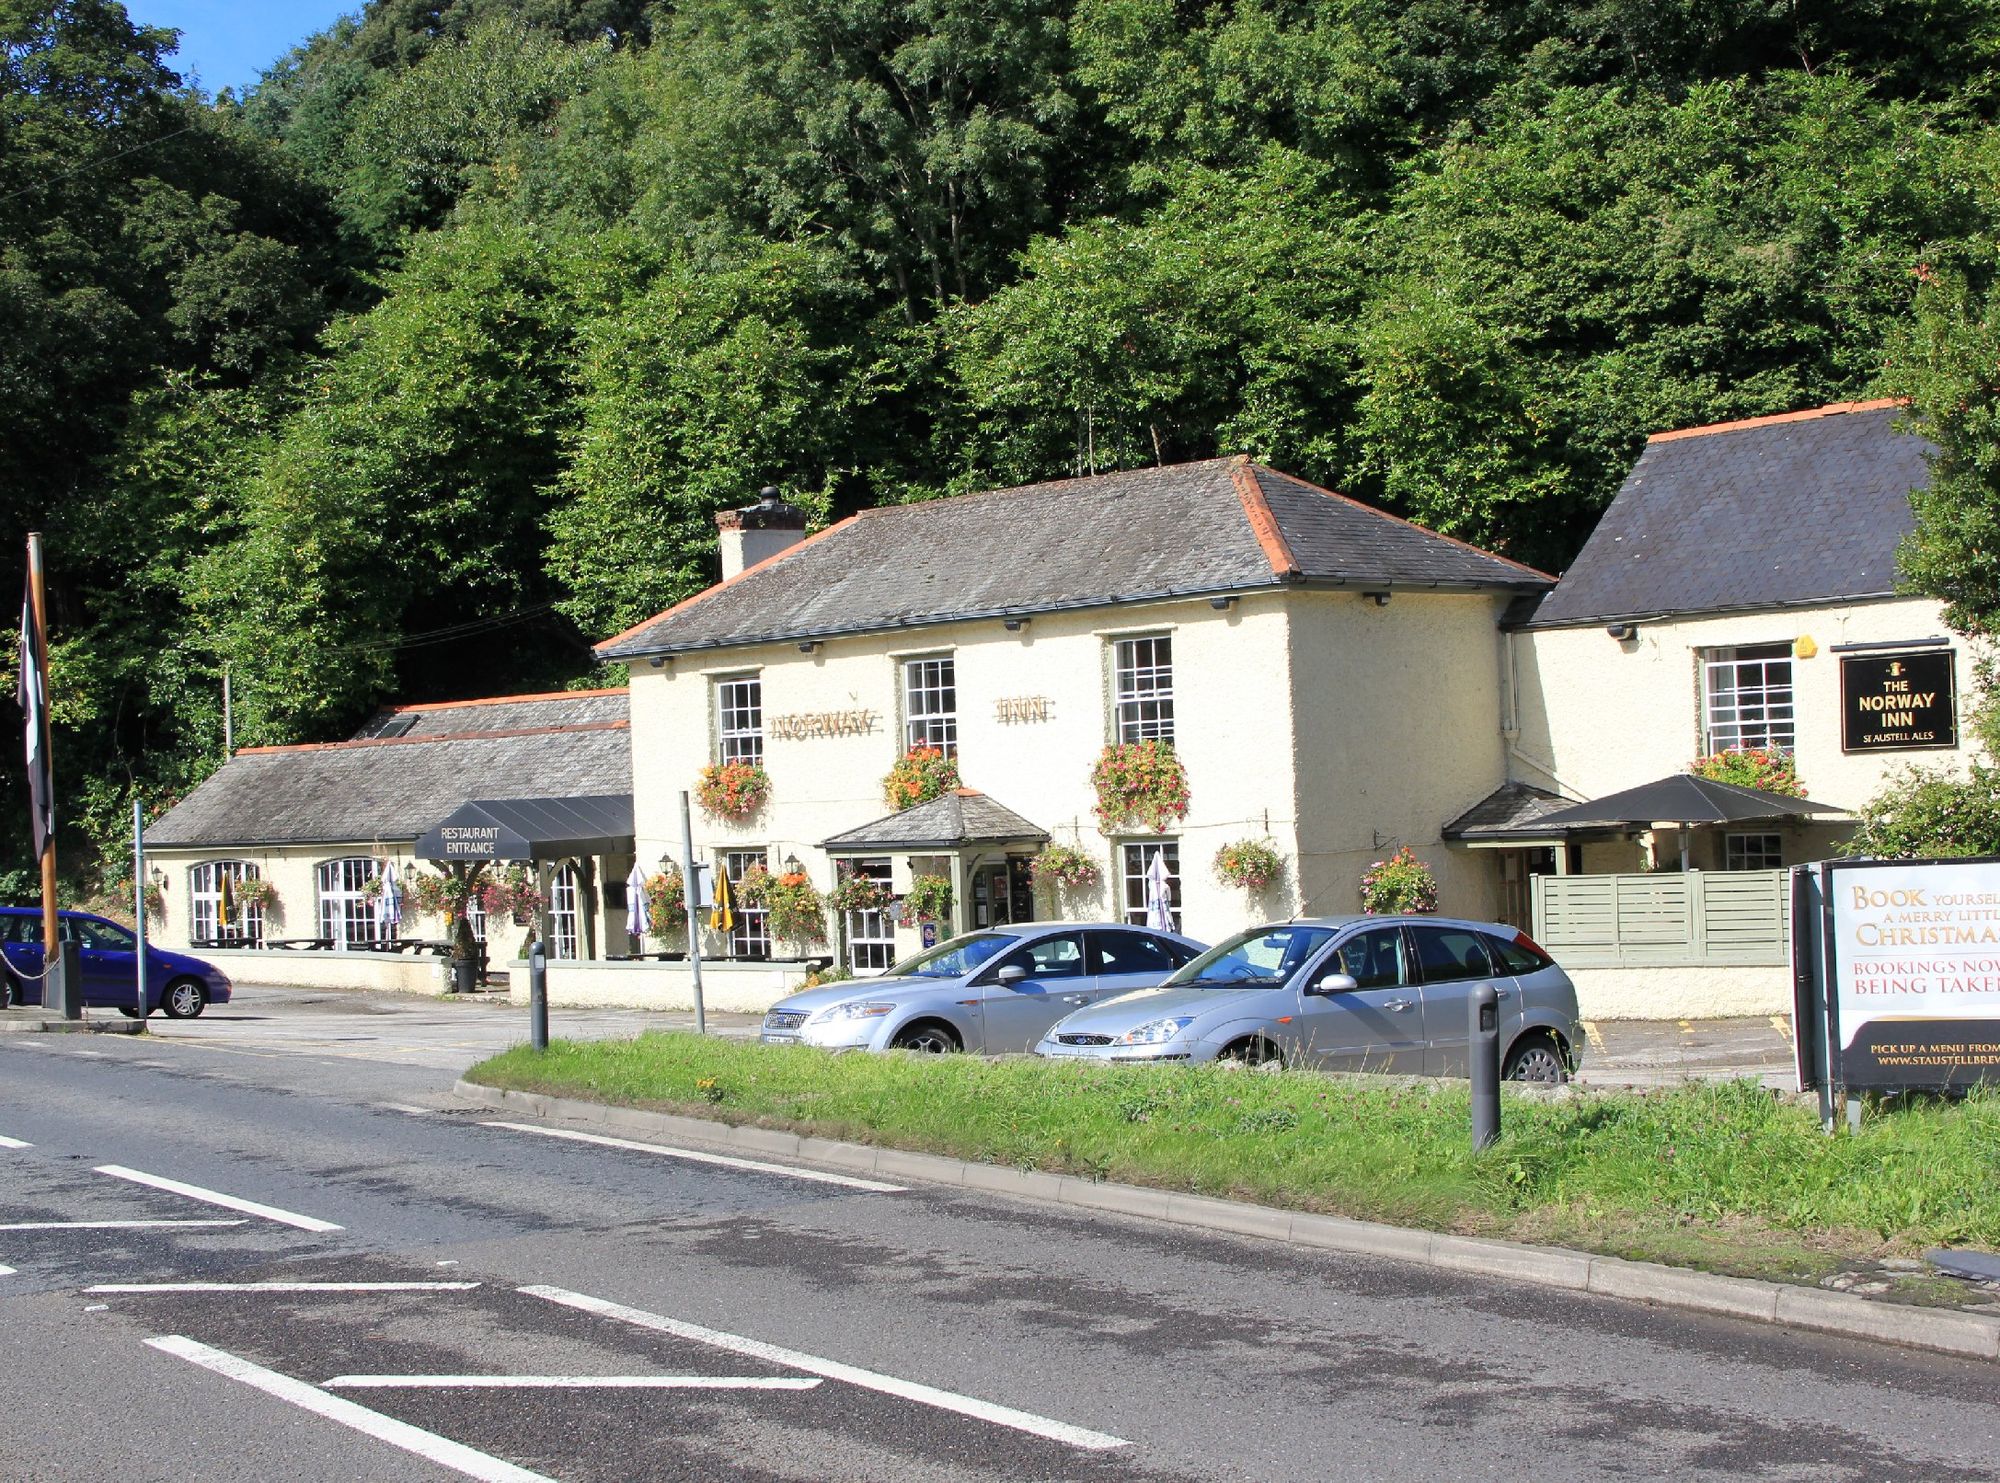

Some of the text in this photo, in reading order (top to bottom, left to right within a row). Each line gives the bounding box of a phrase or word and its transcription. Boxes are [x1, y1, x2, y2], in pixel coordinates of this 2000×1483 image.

[1883, 680, 1909, 692] THE
[1859, 692, 1935, 712] NORWAY
[772, 694, 1044, 738] NORWAY INN
[1881, 711, 1913, 728] INN
[1873, 732, 1910, 743] AUSTELL
[1911, 731, 1934, 741] ALES
[441, 827, 500, 839] RESTAURANT
[446, 842, 495, 854] ENTRANCE
[1883, 909, 2000, 923] A MERRY LITTL
[1855, 922, 2000, 947] CHRISTMA
[1853, 961, 1957, 975] BOOKINGS
[1855, 977, 1927, 995] BEING
[1871, 1043, 2000, 1054] PICK UP A MENU FROM
